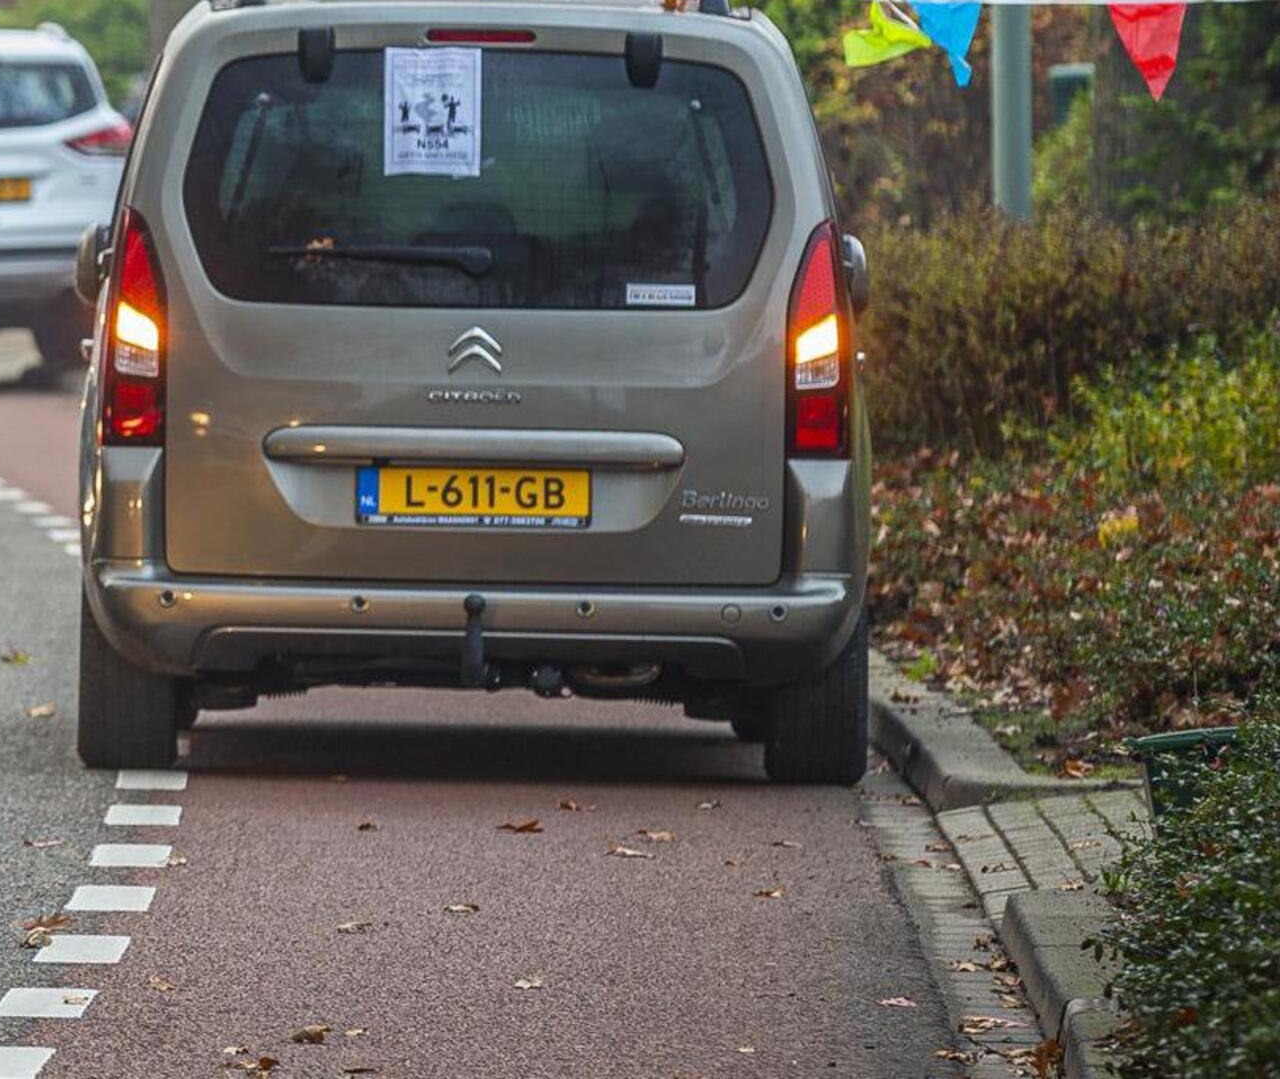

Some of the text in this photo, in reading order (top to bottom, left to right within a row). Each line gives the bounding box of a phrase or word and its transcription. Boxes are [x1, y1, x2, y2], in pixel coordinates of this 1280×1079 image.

[360, 495, 376, 507] NL
[405, 474, 566, 509] L-611-GB
[682, 488, 770, 511] Berlingo
